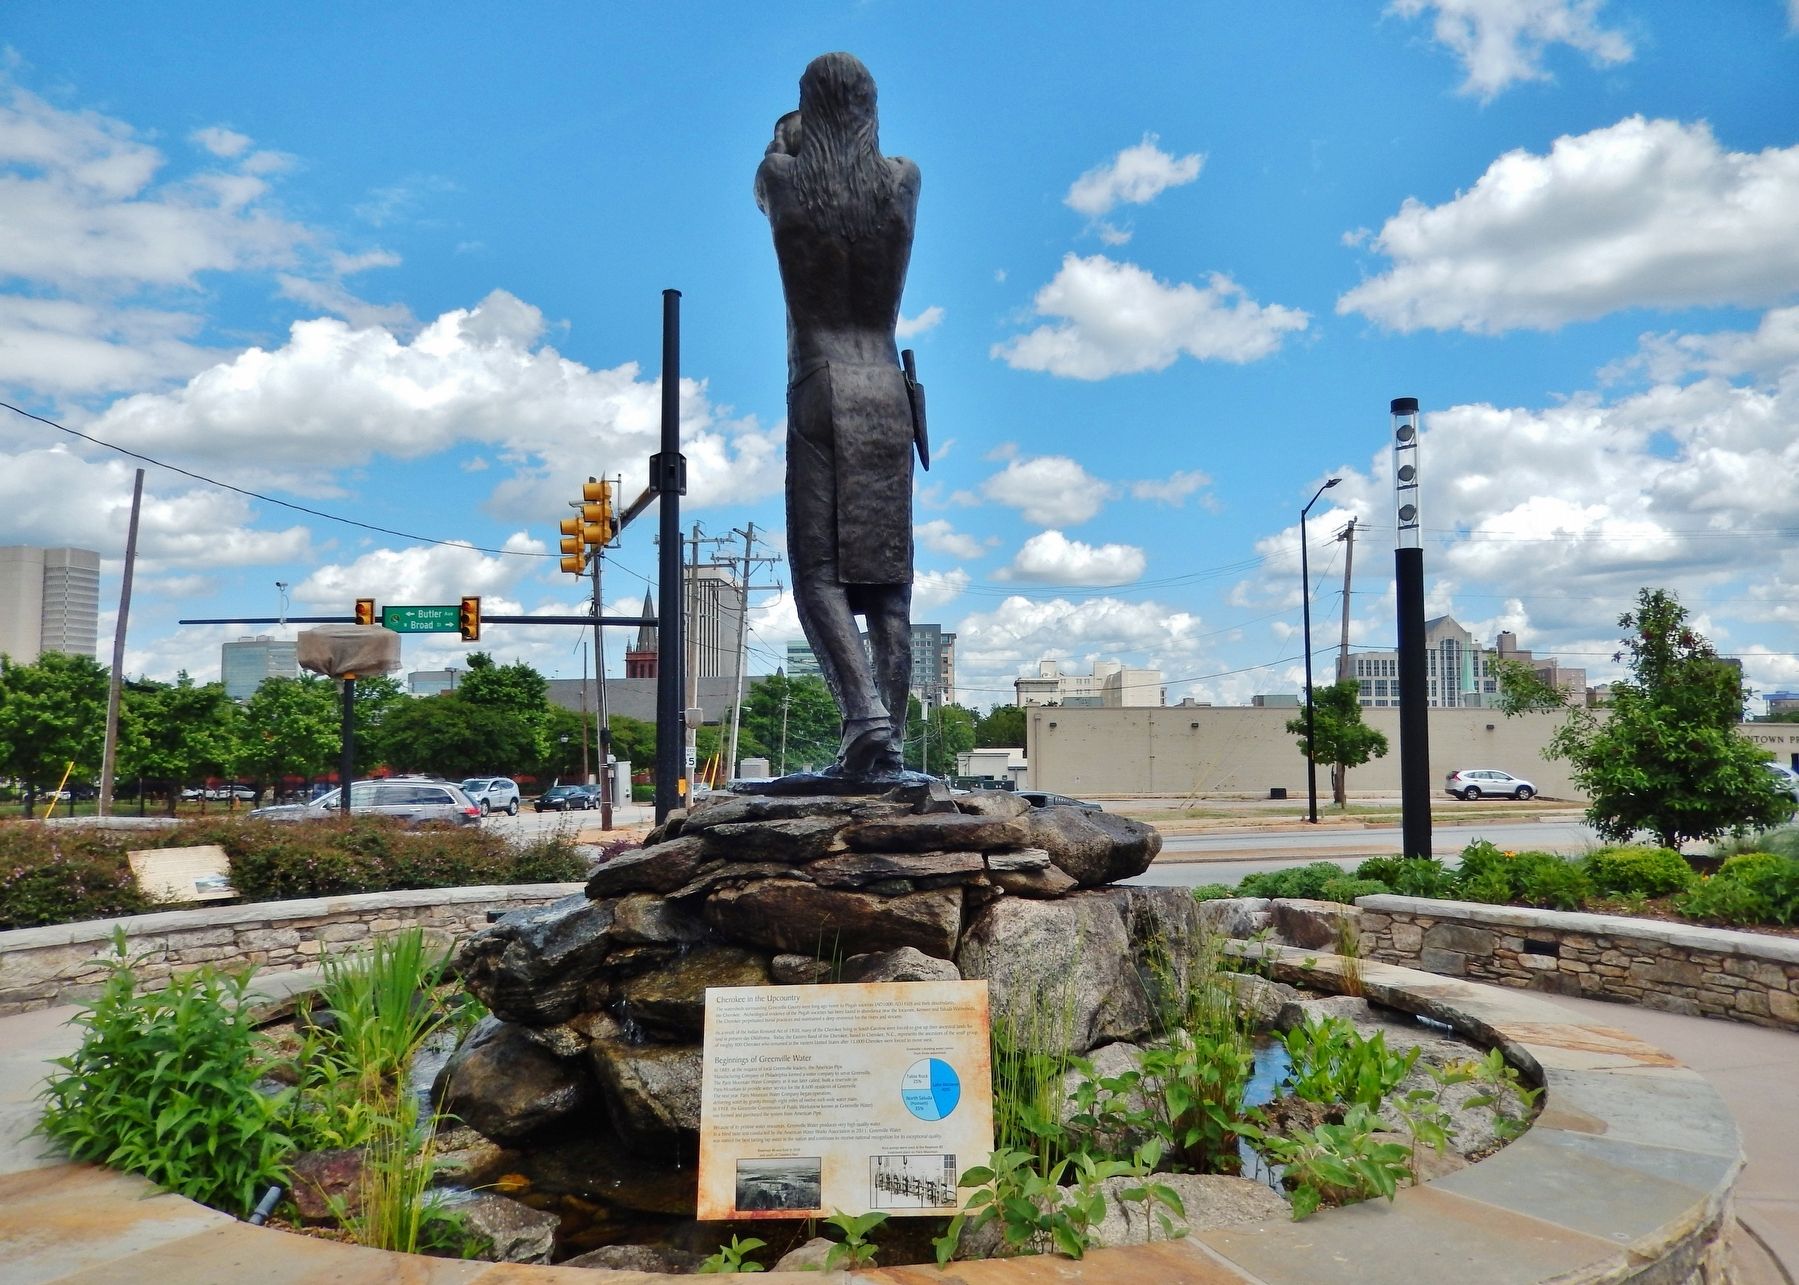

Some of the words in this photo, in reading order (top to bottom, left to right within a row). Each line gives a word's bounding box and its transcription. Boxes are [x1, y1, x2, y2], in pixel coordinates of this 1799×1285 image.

[418, 610, 442, 618] Butler
[411, 621, 433, 629] Broad
[767, 995, 800, 1003] Upcountry
[714, 1057, 748, 1066] Beginnings
[759, 1055, 790, 1063] Greenville
